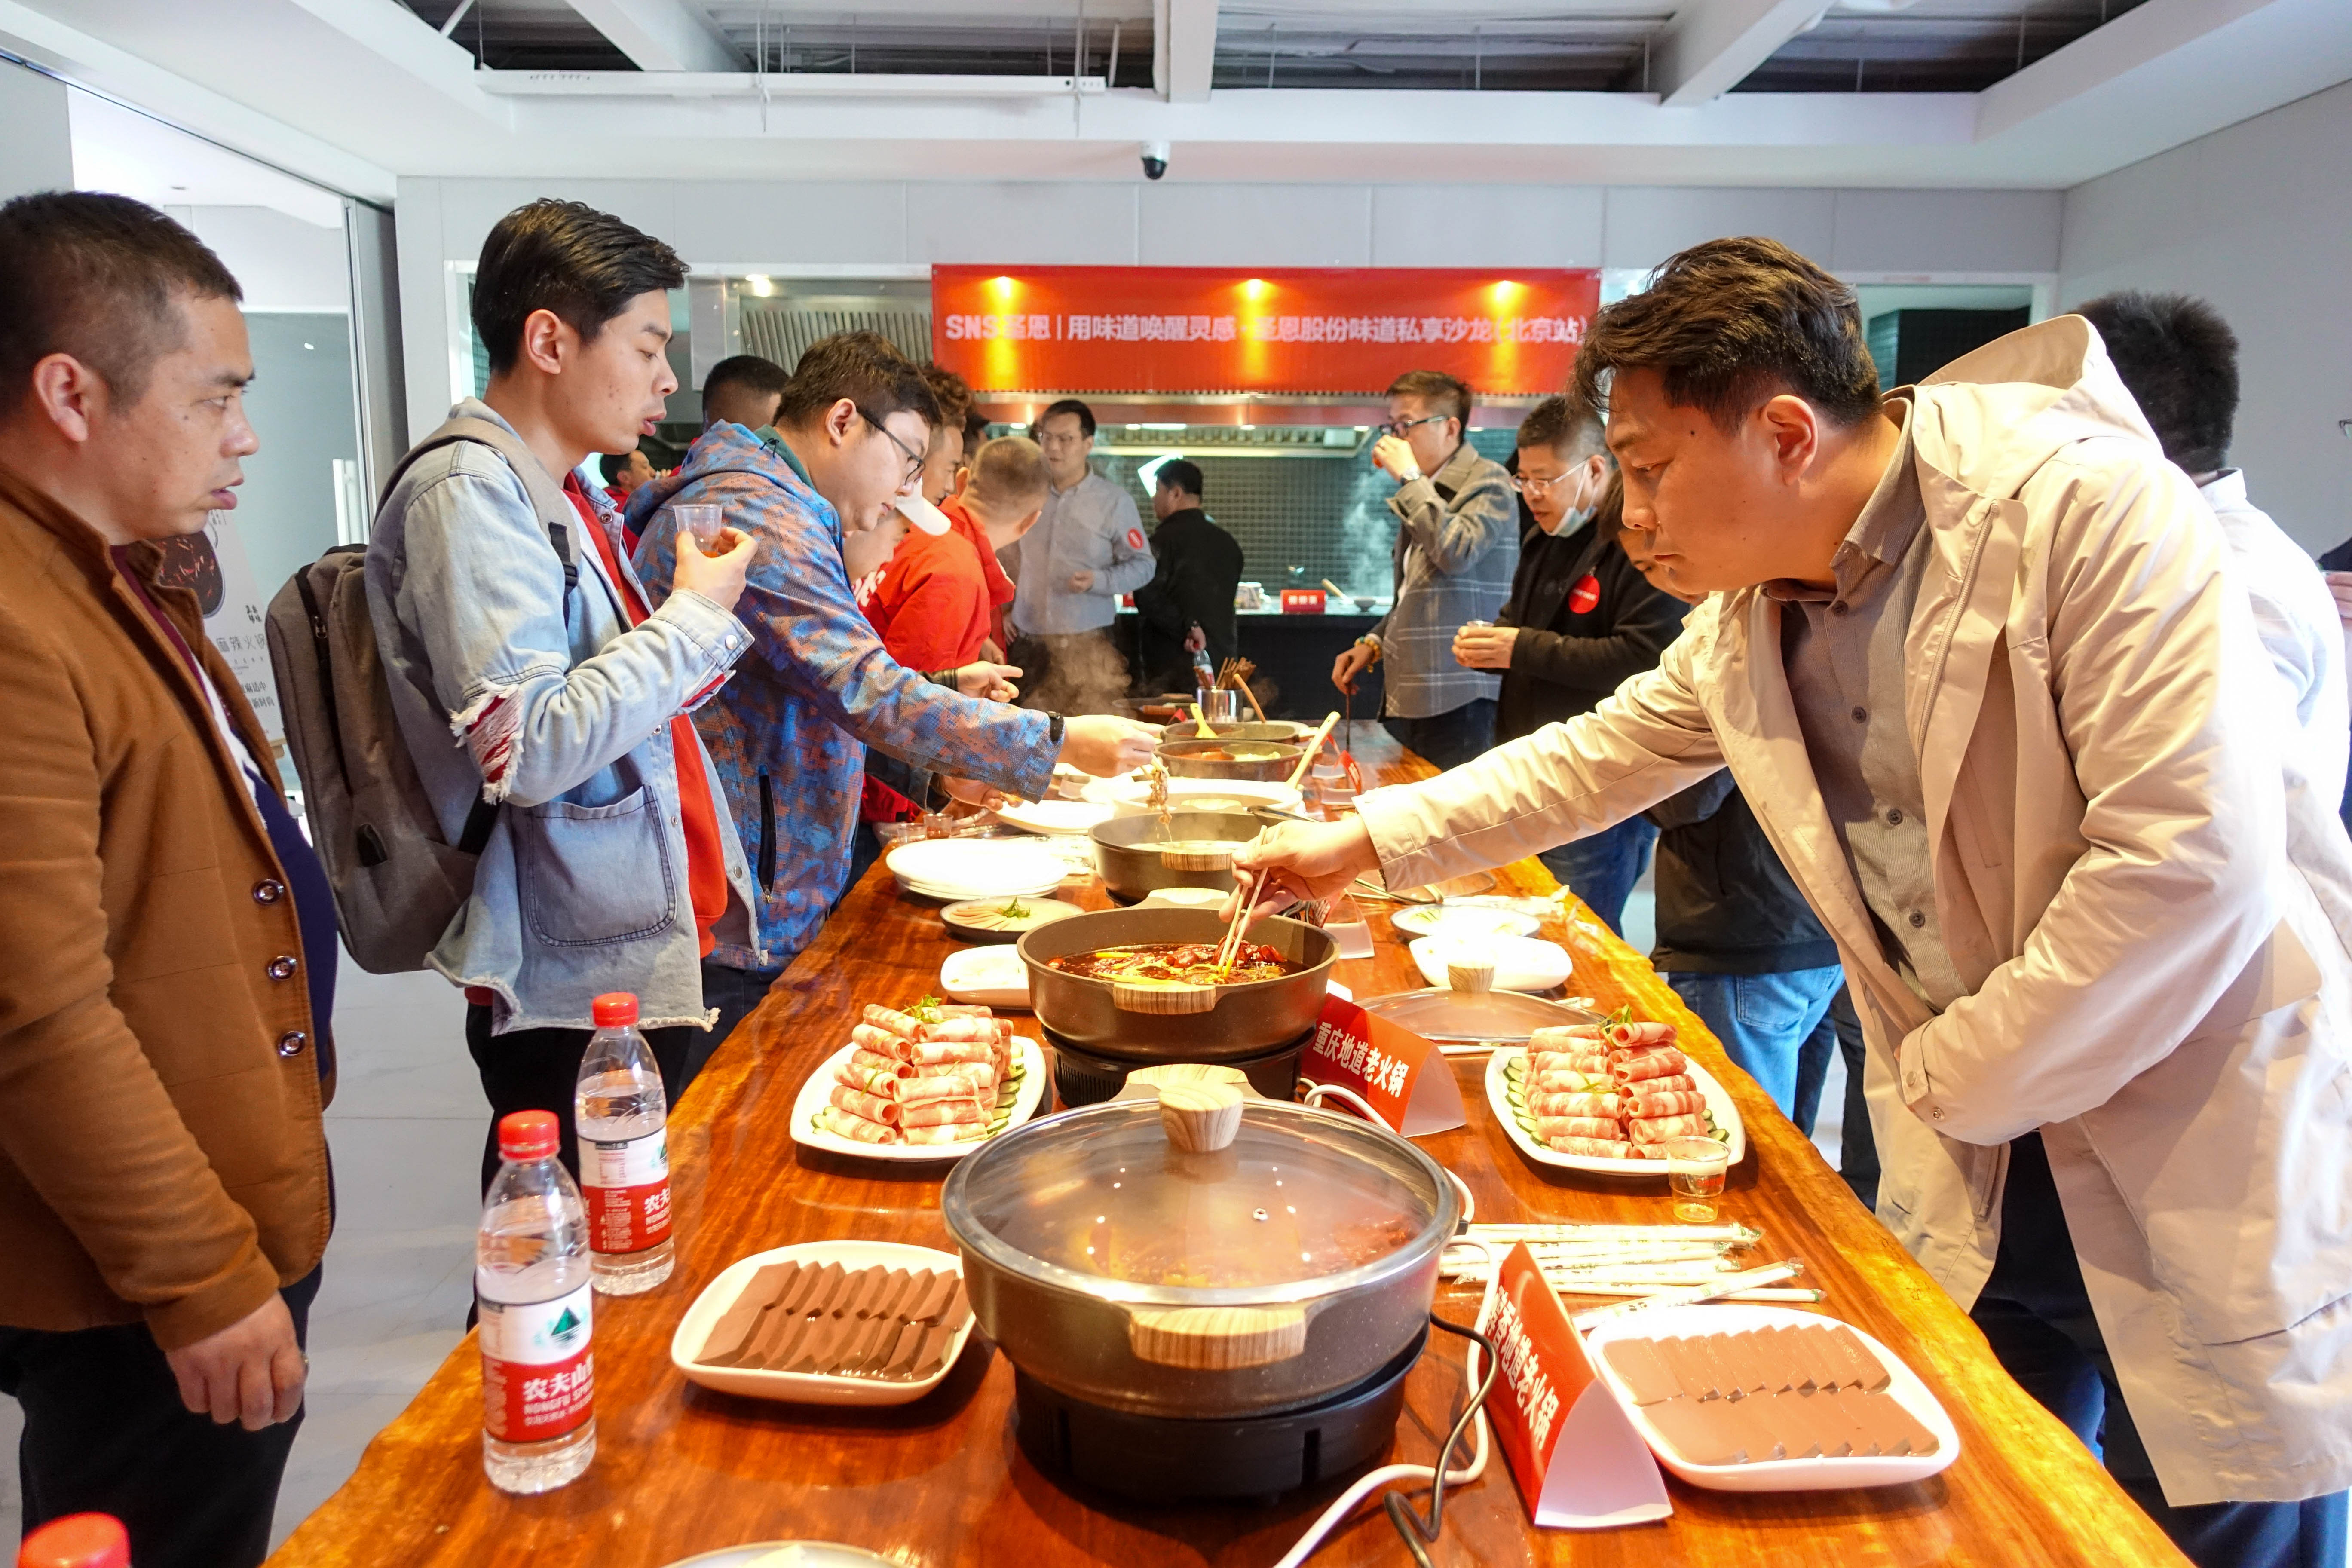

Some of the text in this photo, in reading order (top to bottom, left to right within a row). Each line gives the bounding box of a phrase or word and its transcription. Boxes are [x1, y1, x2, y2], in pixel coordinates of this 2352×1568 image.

[1312, 1021, 1409, 1098] 重庆地道老火锅
